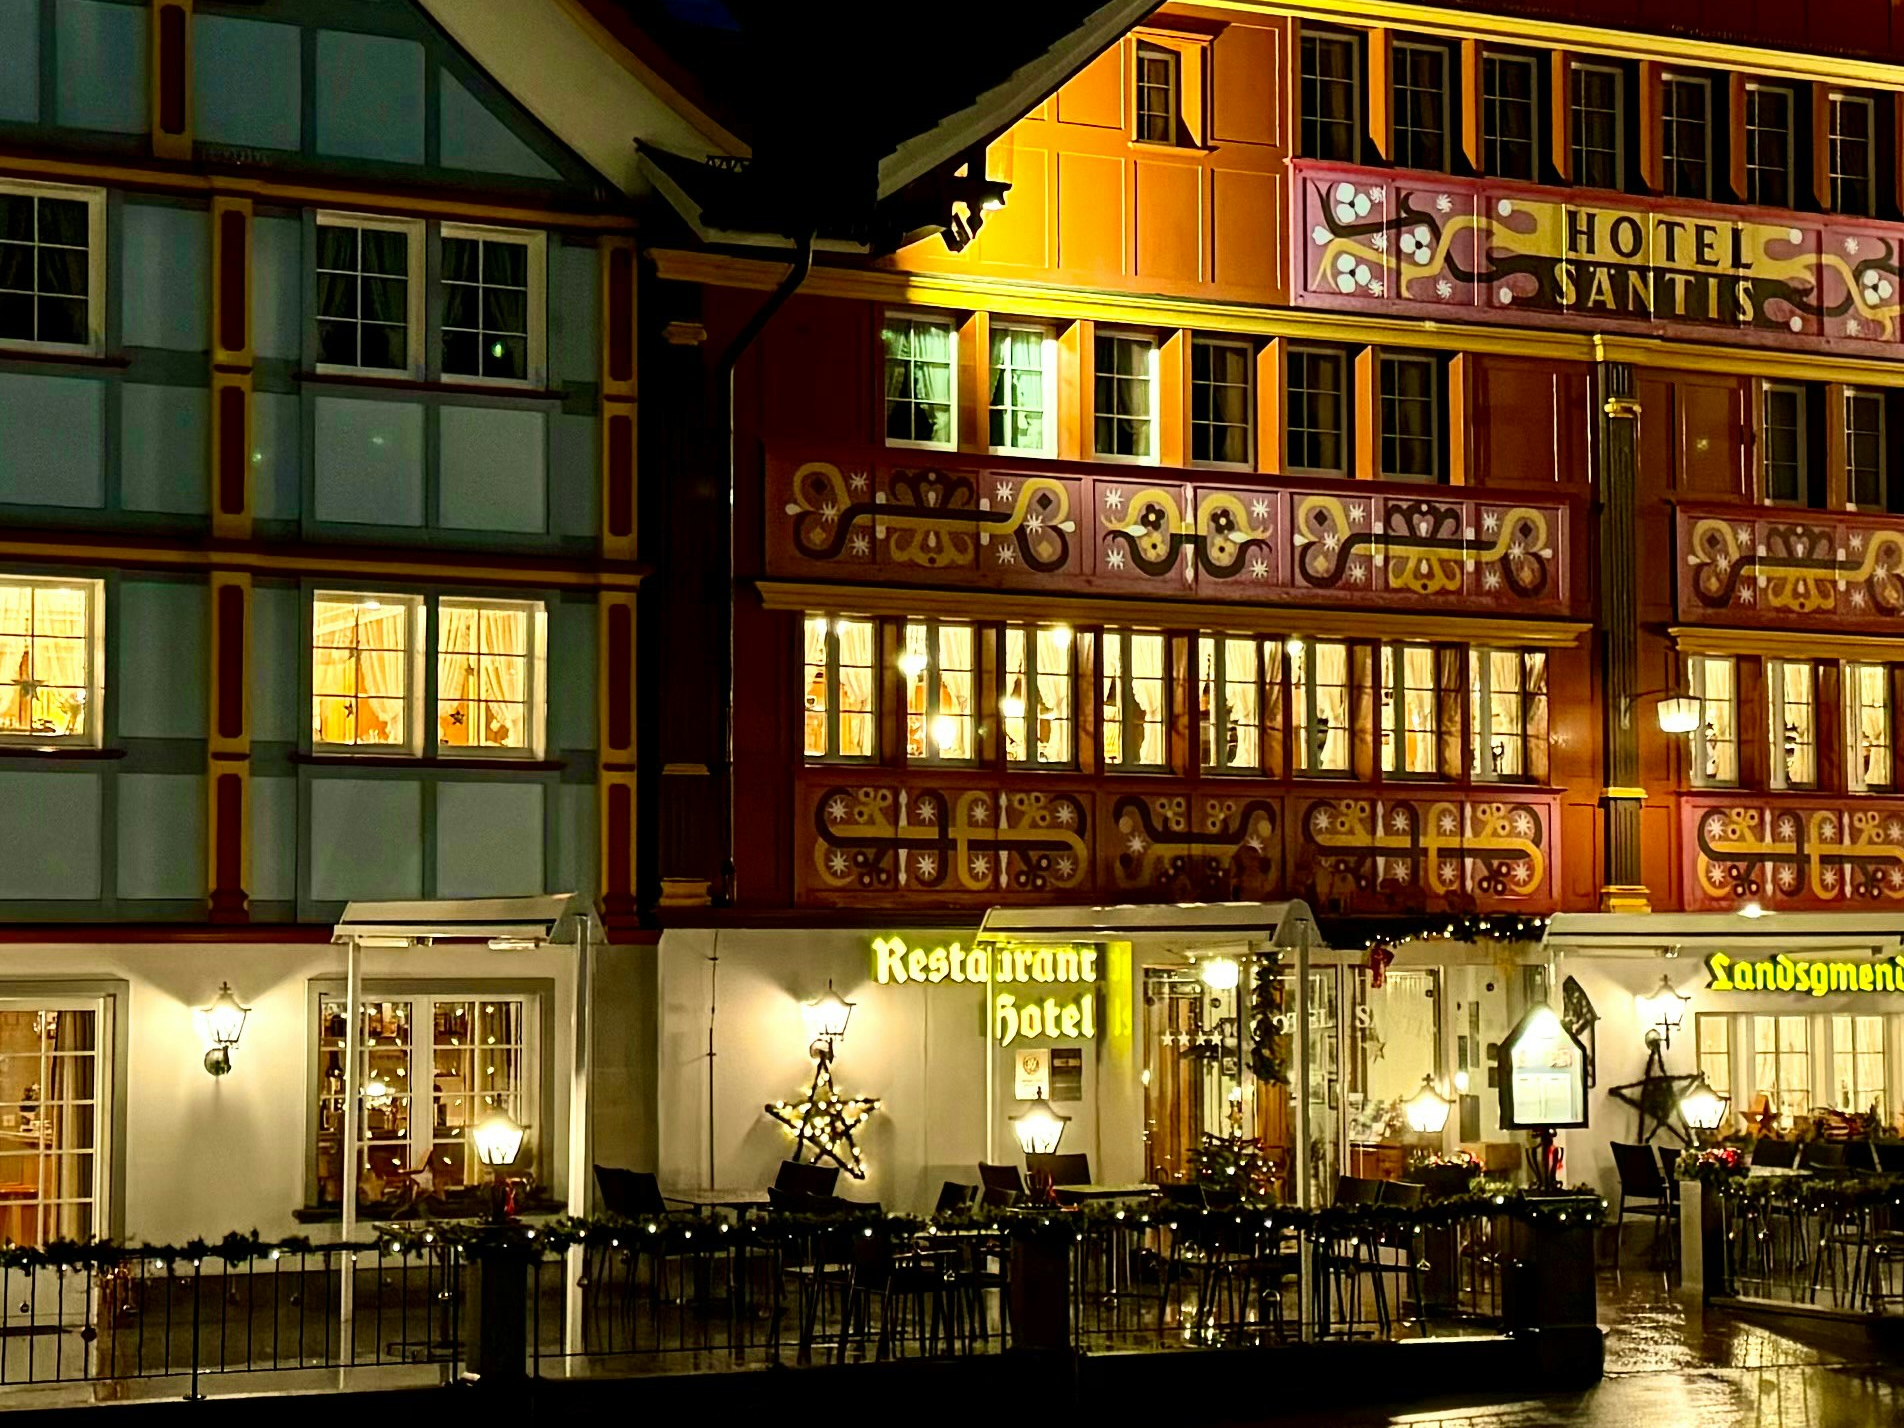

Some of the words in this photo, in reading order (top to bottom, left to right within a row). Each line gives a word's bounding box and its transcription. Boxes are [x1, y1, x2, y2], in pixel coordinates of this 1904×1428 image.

[1566, 209, 1753, 270] HOTEL
[1553, 262, 1755, 322] SÄNTIS
[871, 935, 1097, 985] Restaurant
[995, 992, 1095, 1047] Hotel
